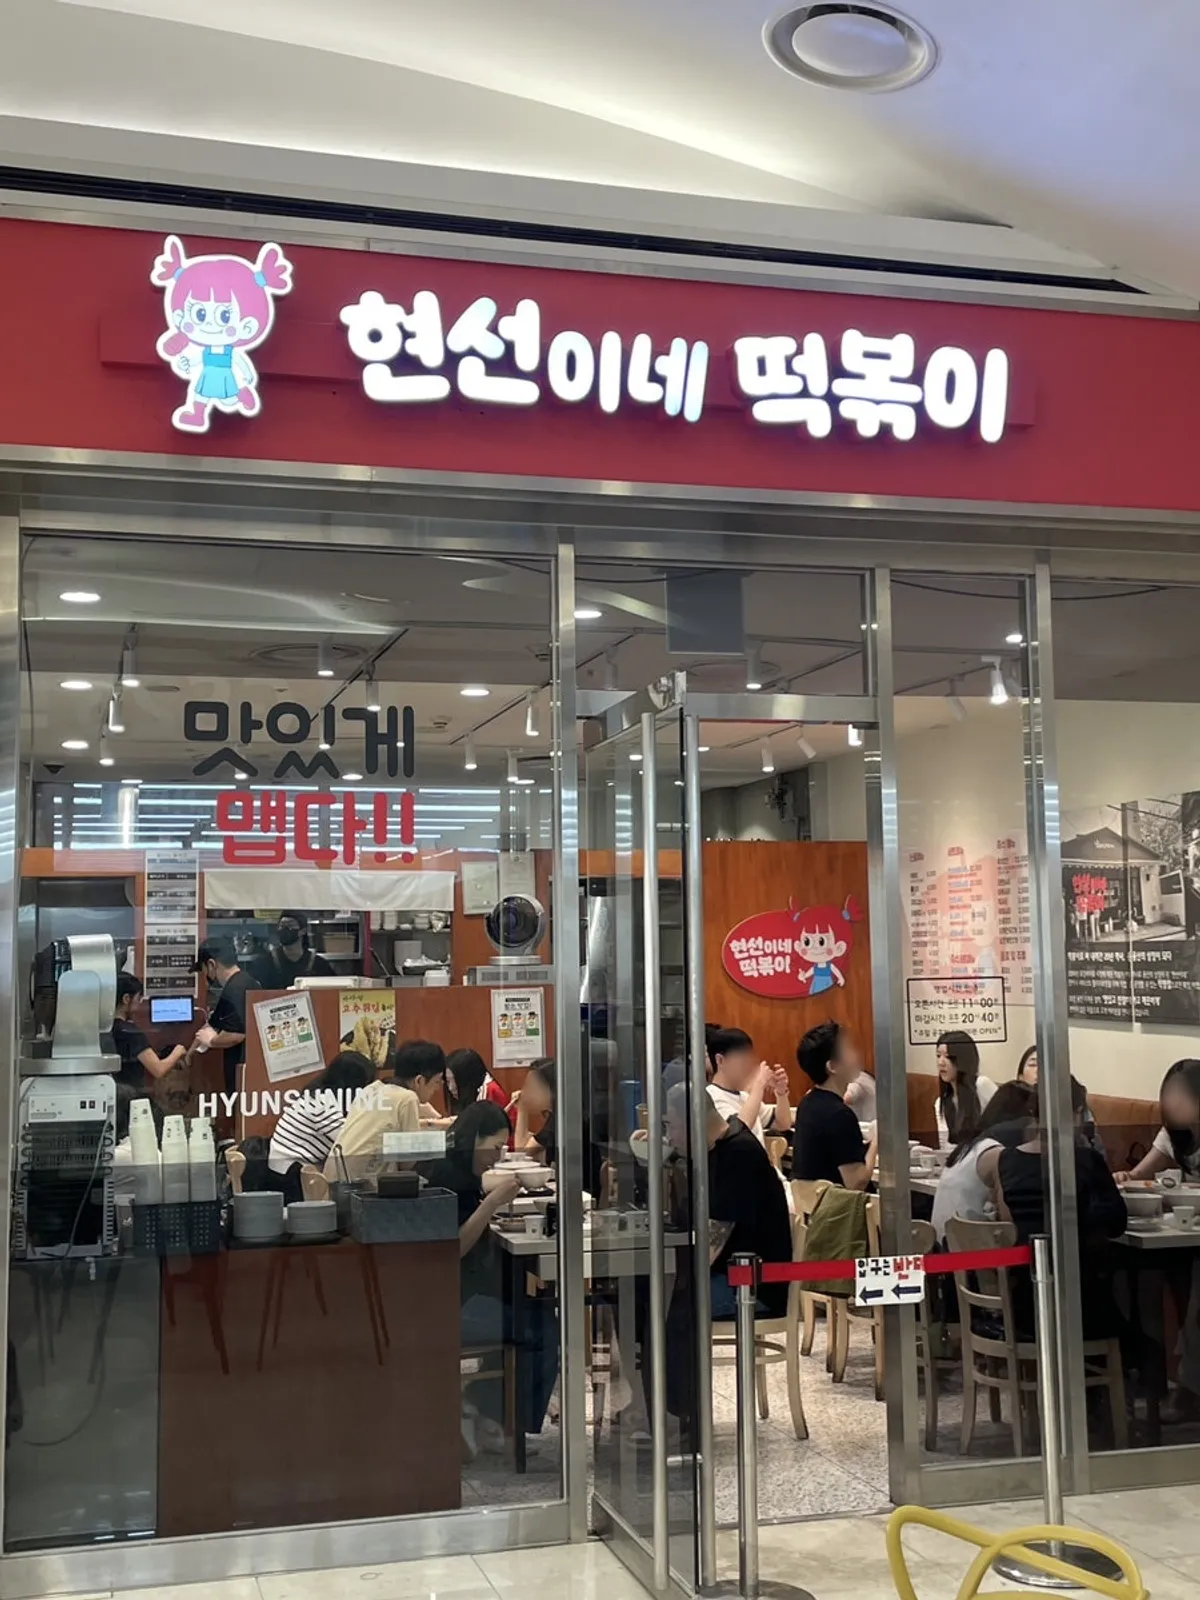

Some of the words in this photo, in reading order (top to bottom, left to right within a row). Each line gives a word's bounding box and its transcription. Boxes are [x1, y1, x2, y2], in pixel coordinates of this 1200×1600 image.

[339, 290, 709, 422] 현선이네
[734, 328, 1008, 443] 떡볶이
[184, 701, 414, 779] 맛있게
[216, 790, 415, 865] 맵다!!
[729, 936, 792, 959] 현선이네
[739, 955, 791, 977] 떡볶이
[199, 1087, 393, 1117] HYUNSUNINE
[858, 1259, 890, 1278] 입구는
